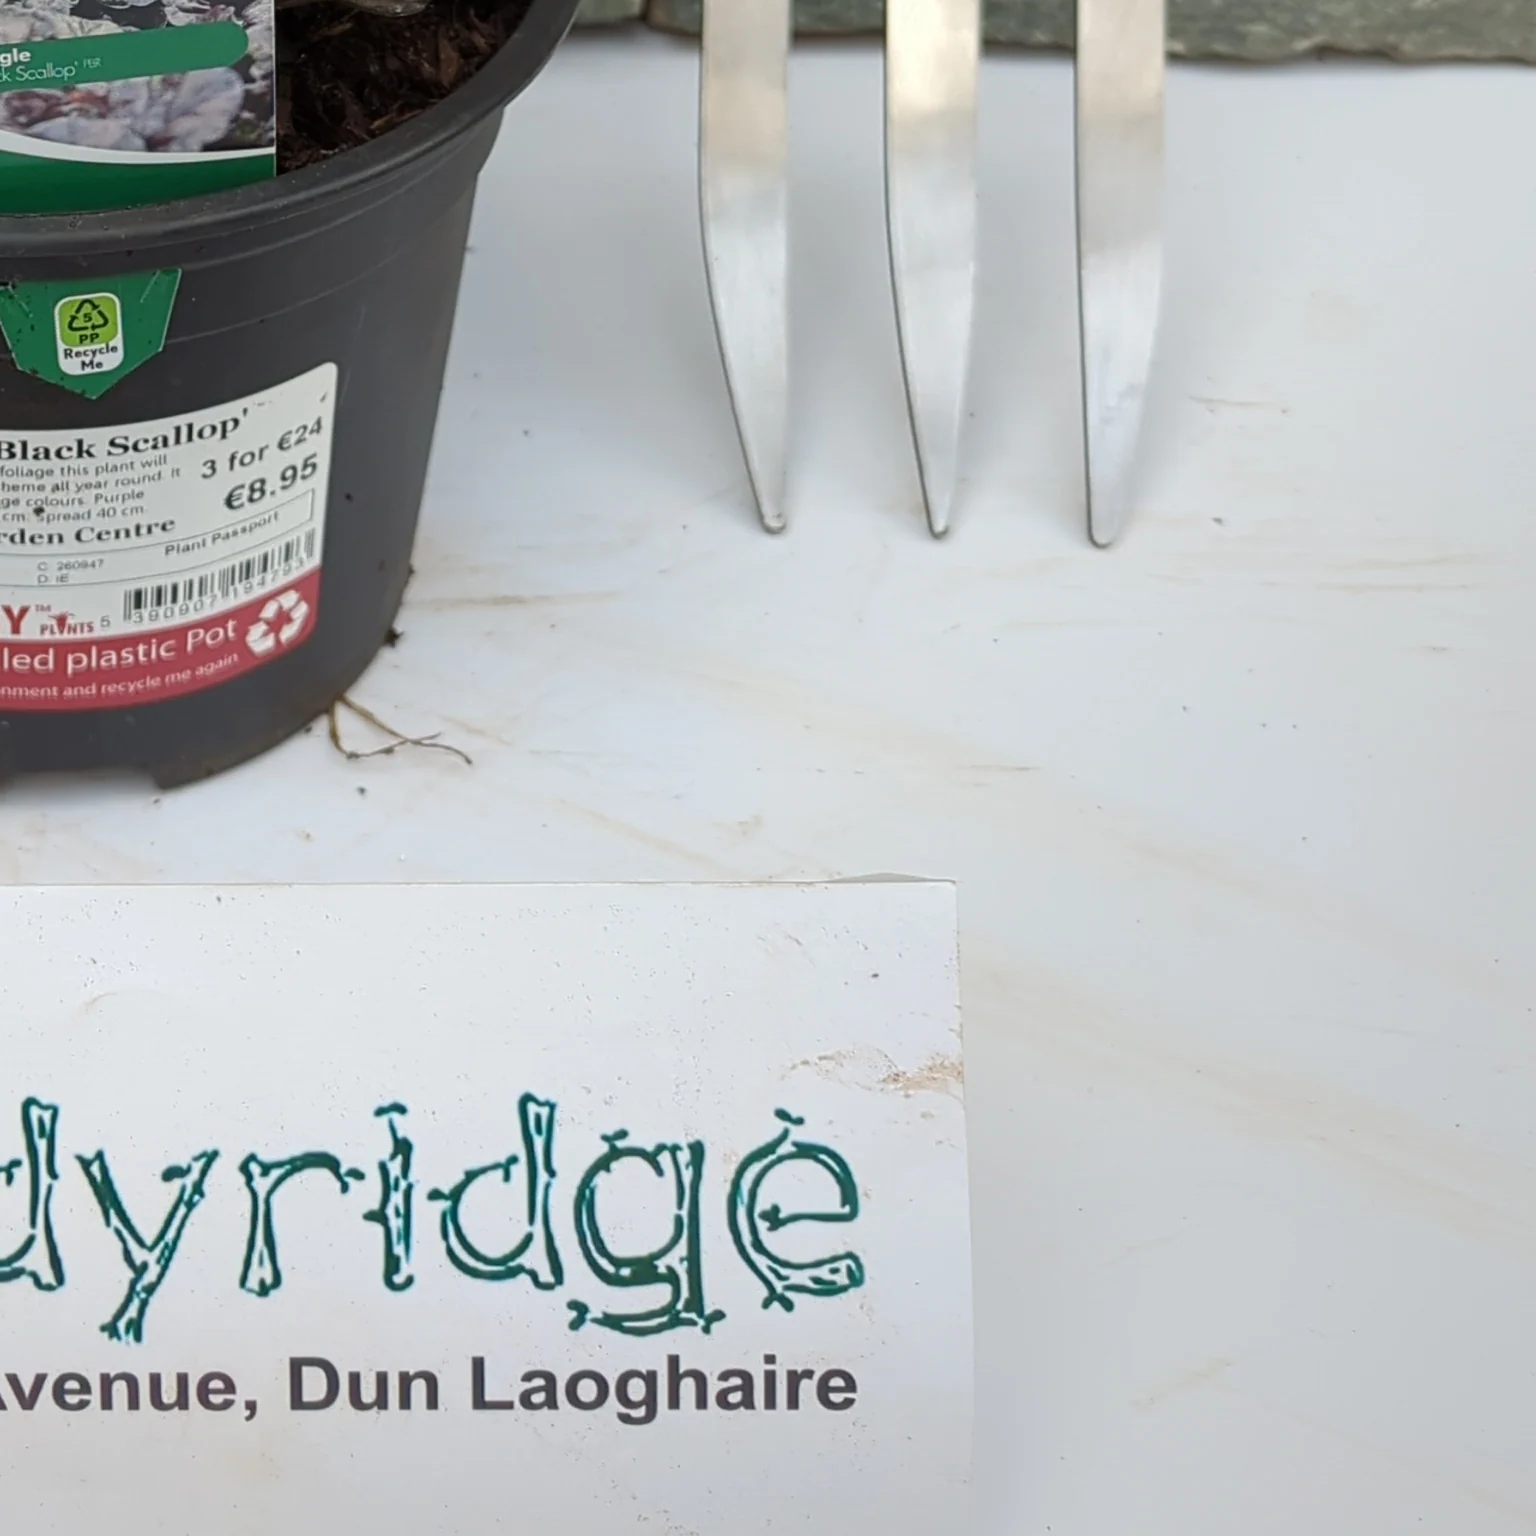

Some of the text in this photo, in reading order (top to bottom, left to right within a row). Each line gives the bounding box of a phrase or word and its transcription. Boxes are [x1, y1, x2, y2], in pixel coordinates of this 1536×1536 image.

[16, 61, 79, 81] Scallop'
[64, 342, 118, 360] Recycle
[79, 332, 100, 344] PP
[81, 359, 104, 371] Me
[106, 407, 249, 457] Scallop'
[201, 416, 323, 479] 3 for €24
[0, 465, 55, 480] foliage
[60, 464, 89, 477] this
[95, 460, 135, 477] plant
[140, 453, 168, 469] will
[51, 479, 70, 494] all
[74, 479, 109, 493] year
[223, 453, 319, 510] €8.95
[94, 489, 145, 504] Purple
[96, 507, 117, 519] 40
[74, 519, 175, 544] Centre
[164, 511, 279, 556] Plant Passport
[66, 637, 176, 678] plastic
[186, 618, 238, 653] Pot
[62, 682, 97, 697] and
[100, 675, 162, 694] recycle
[164, 669, 193, 685] me
[195, 651, 240, 676] again
[288, 1356, 440, 1411] Dun
[470, 1354, 858, 1426] Laoghaire
